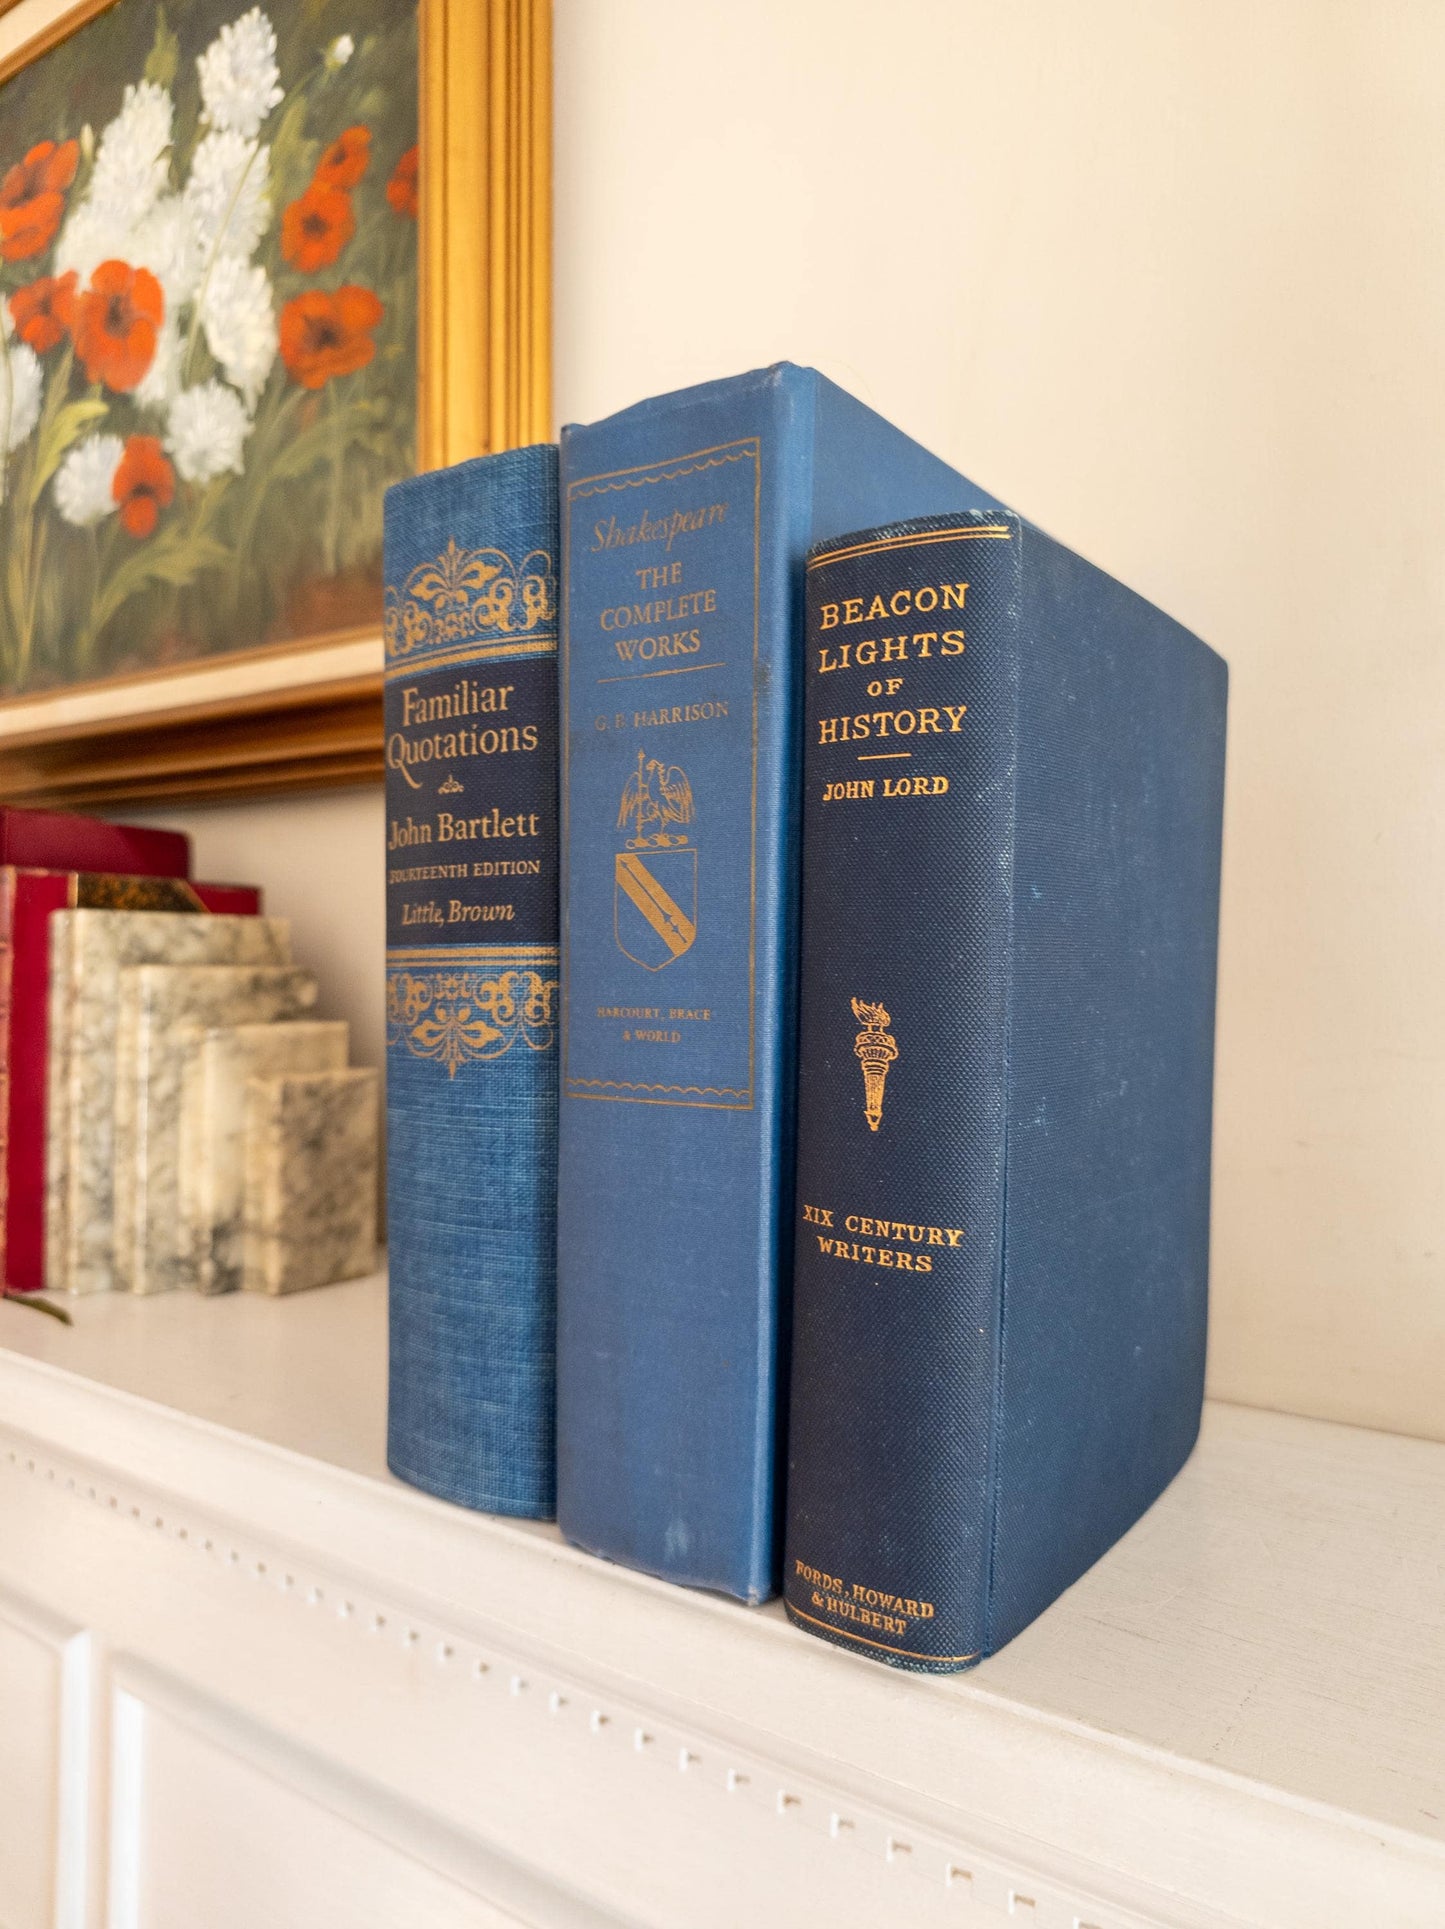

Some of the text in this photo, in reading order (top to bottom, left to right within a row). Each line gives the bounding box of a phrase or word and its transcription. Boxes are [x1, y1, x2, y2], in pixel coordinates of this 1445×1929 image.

[636, 561, 684, 590] THE
[600, 589, 717, 632] COMPLETE
[819, 582, 970, 630] BEACON
[615, 628, 701, 662] WORKS
[818, 630, 966, 673] LIGHTS
[402, 680, 515, 727] Familiar
[867, 678, 904, 697] OF
[633, 701, 729, 728] HARRISON
[818, 705, 967, 744] HISTORY
[387, 723, 539, 789] Quotations
[822, 776, 949, 801] JOHN LORD
[388, 808, 540, 850] John Bartlett
[389, 860, 541, 884] FOURTEENTH EDITION
[402, 900, 515, 927] Little, Brown
[669, 1007, 711, 1021] BRACE
[622, 1030, 681, 1043] & WORLD
[802, 1204, 965, 1247] XIX CENTURY
[816, 1235, 933, 1272] WRITERS
[811, 1591, 907, 1636] & HULBERT
[852, 1583, 935, 1618] HOWARD
